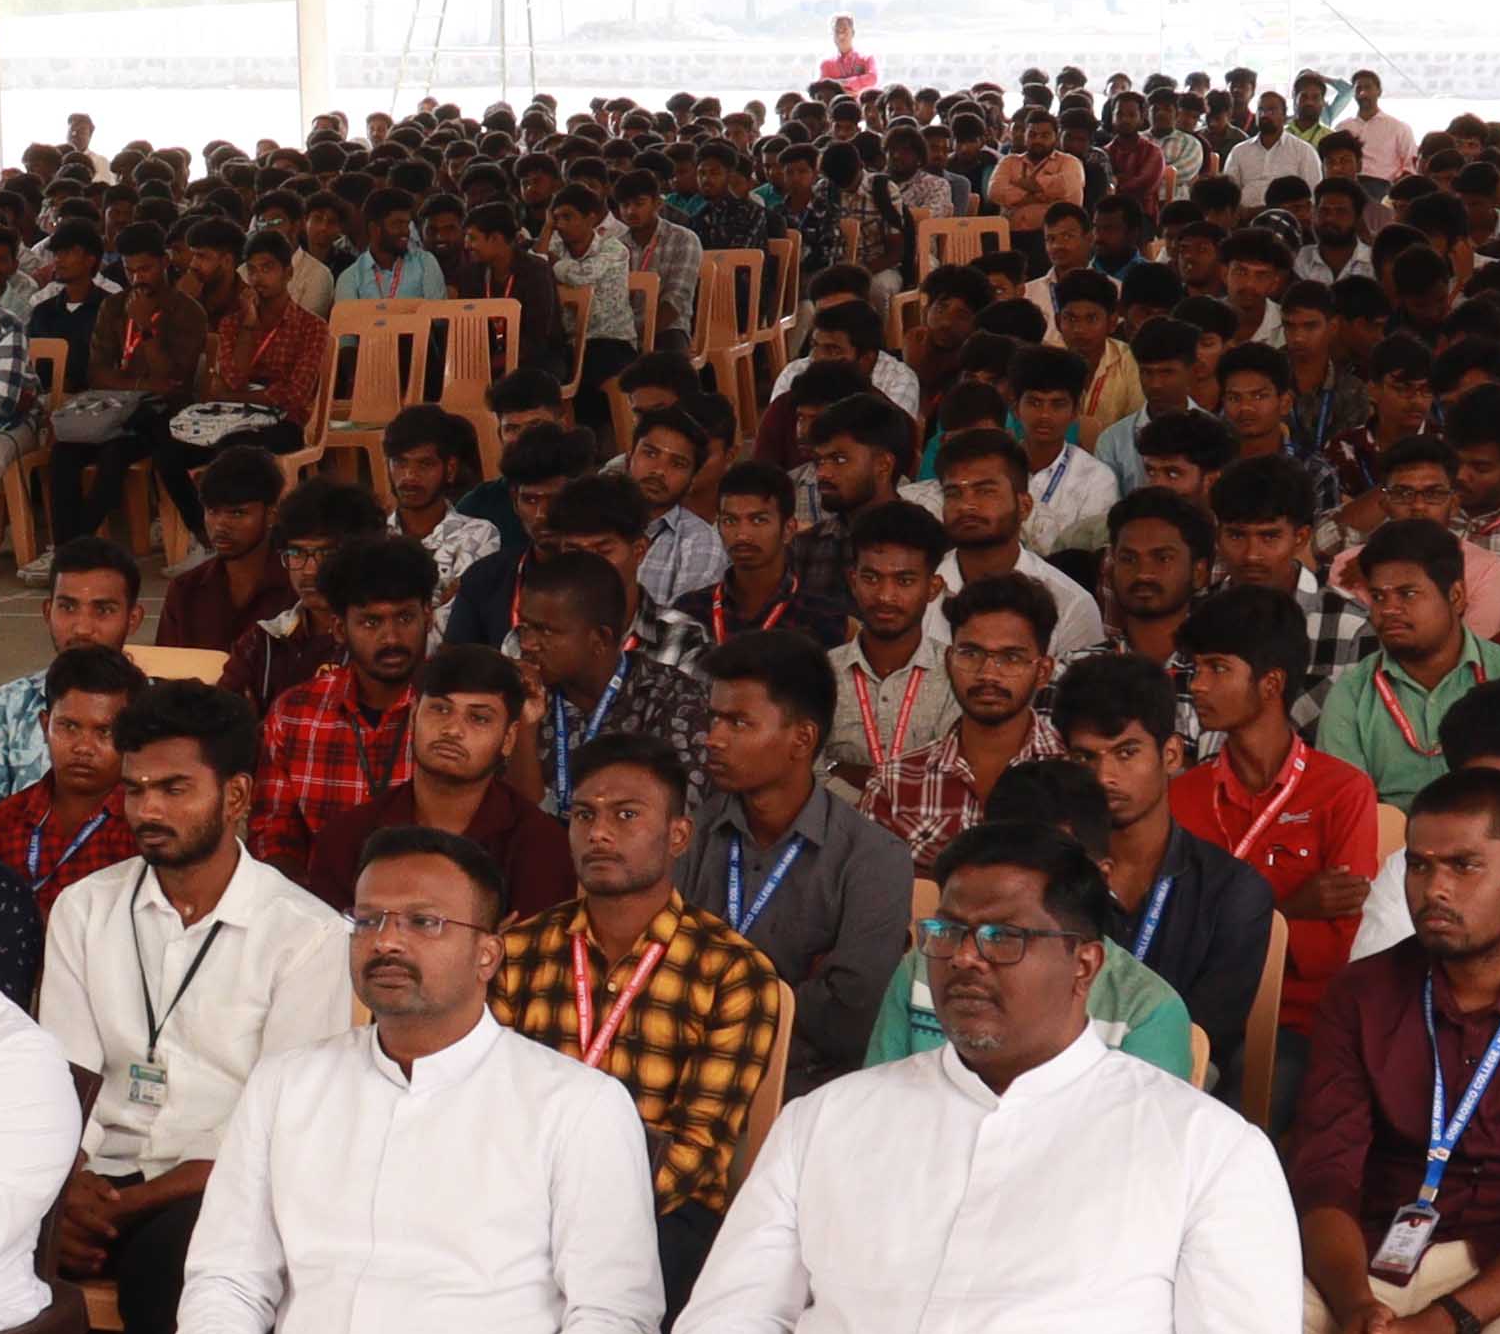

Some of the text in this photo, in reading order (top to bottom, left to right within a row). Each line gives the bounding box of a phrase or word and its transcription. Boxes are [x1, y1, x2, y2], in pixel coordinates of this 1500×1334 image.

[1445, 1119, 1462, 1141] DON
[1455, 1088, 1479, 1122] BOSCO
[1471, 1048, 1500, 1091] COLLEGE
